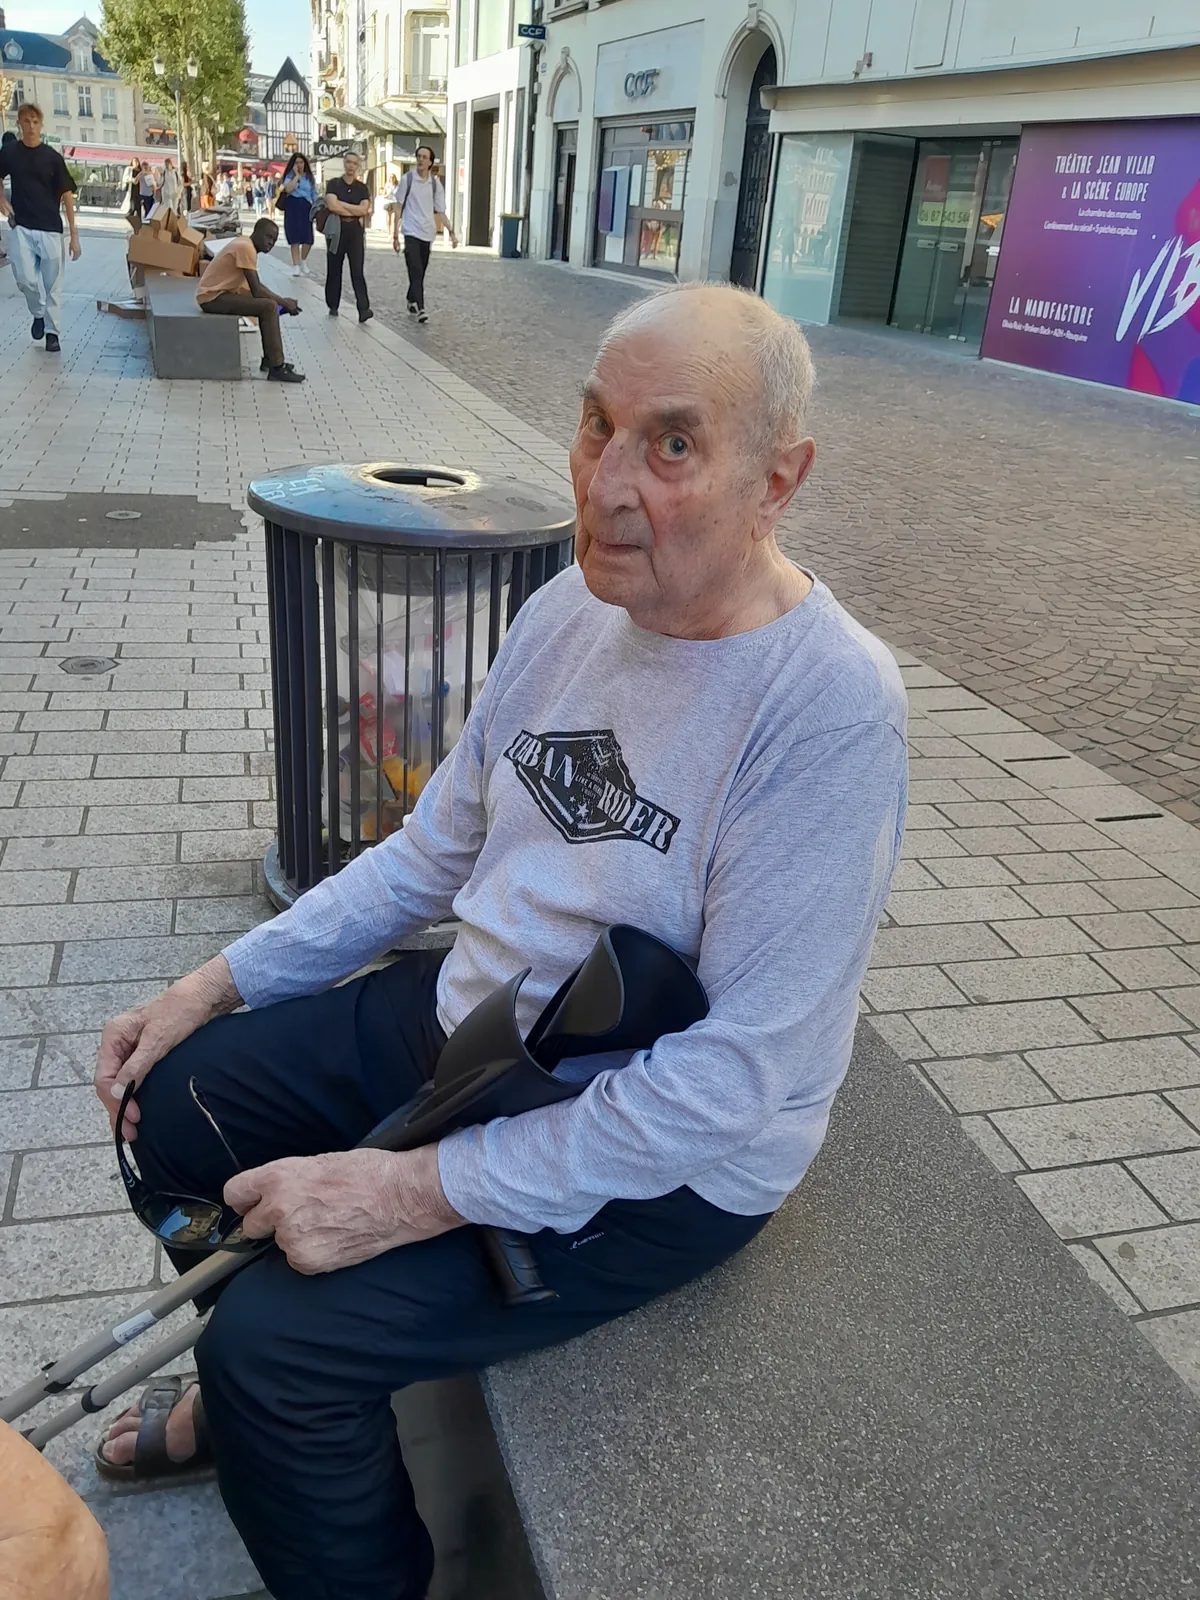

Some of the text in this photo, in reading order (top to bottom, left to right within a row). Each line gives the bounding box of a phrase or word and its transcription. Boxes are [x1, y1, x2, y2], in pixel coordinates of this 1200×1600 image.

[520, 26, 543, 36] CCF
[624, 68, 661, 98] CCF
[1055, 153, 1156, 175] THÉÂTRE JEAN VILAR
[1070, 181, 1081, 199] LA
[1083, 179, 1112, 201] SCÈNE
[1114, 182, 1150, 202] EUROPE
[1008, 296, 1094, 326] LA MANUFACTURE
[508, 733, 581, 788] UBAN
[575, 774, 588, 786] LIKE
